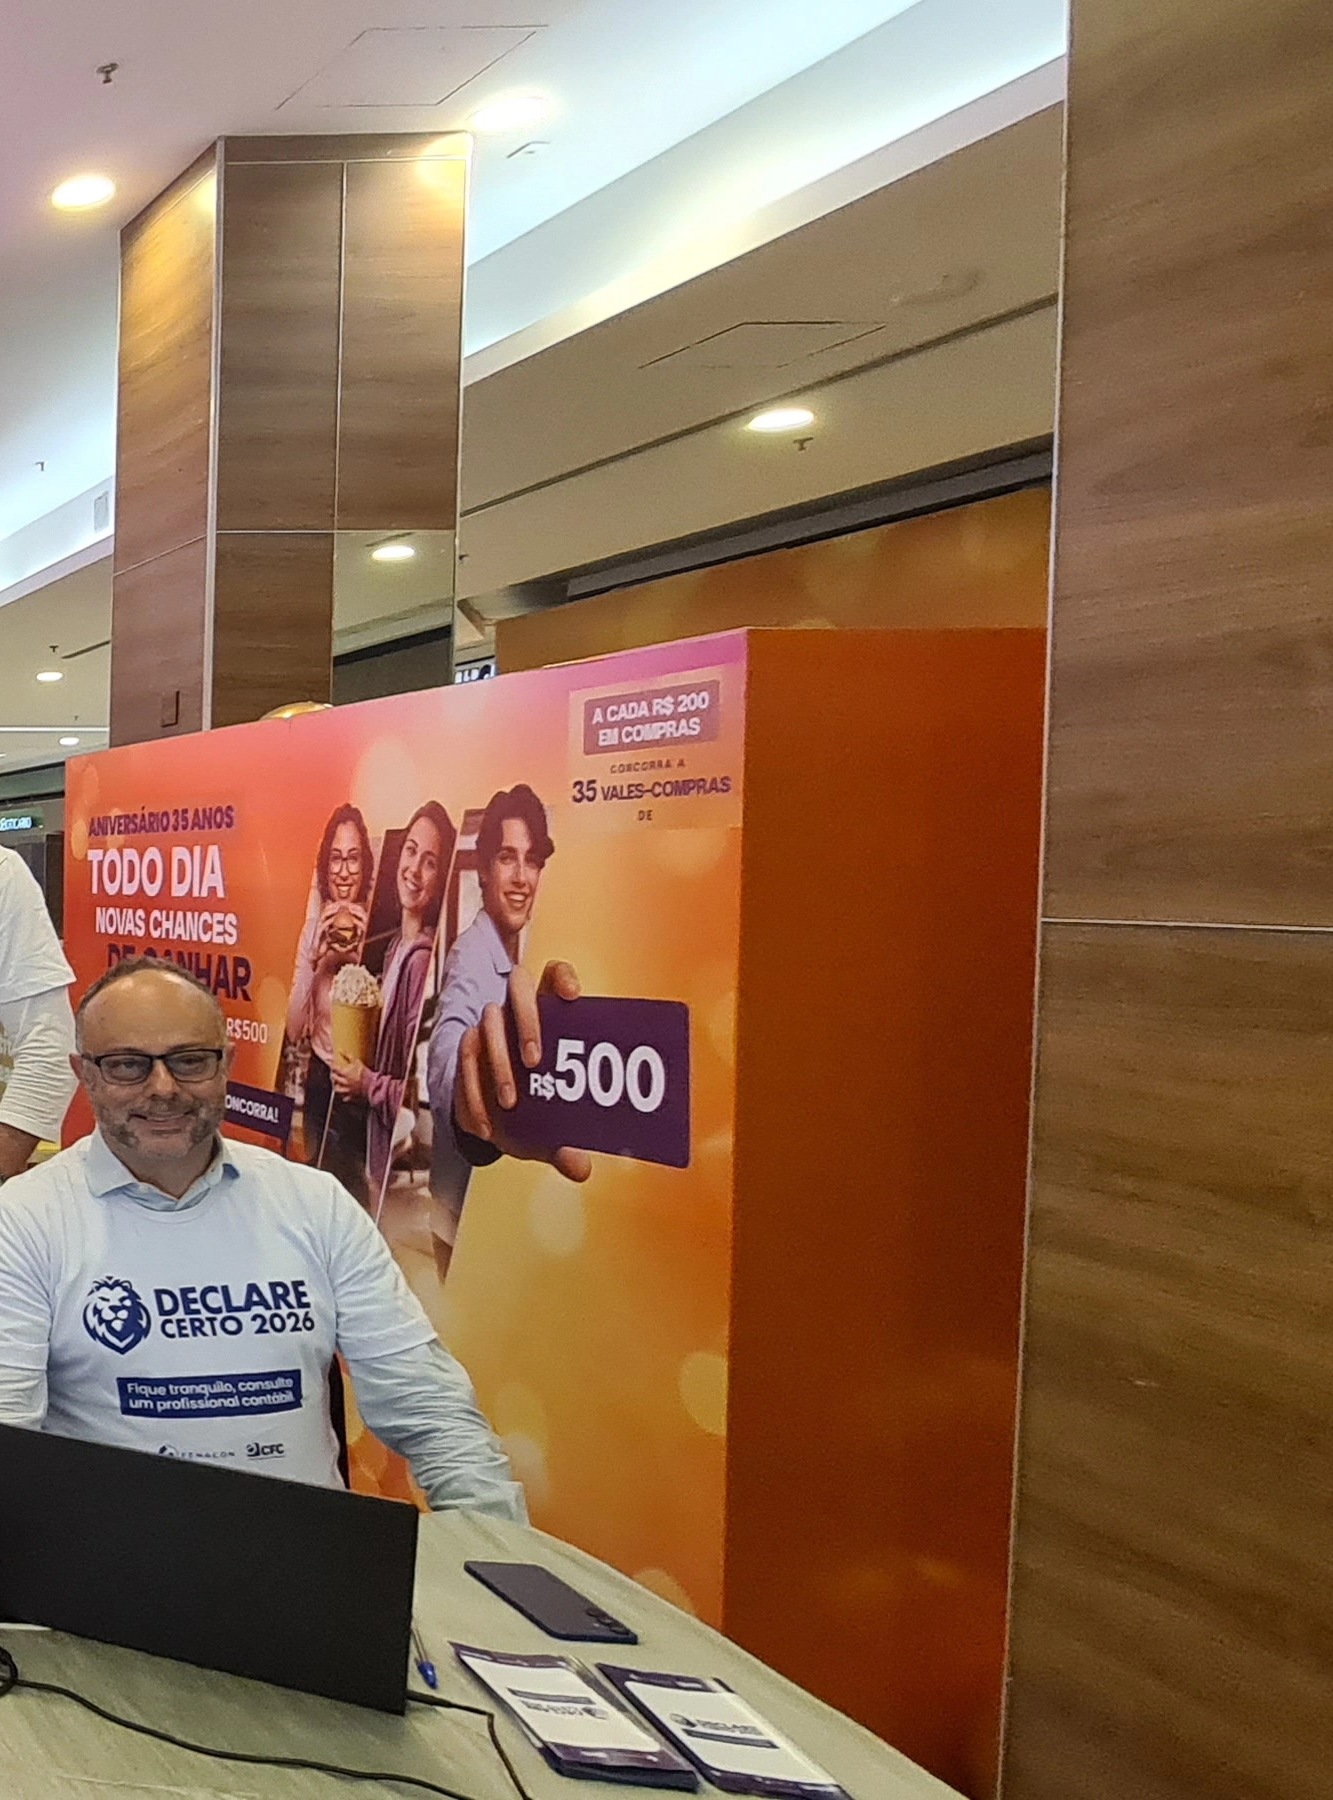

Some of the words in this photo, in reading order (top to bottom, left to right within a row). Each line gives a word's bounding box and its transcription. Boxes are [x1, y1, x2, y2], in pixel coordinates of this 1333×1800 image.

[591, 708, 604, 725] A
[606, 700, 649, 722] CADA
[652, 695, 674, 717] R$
[677, 691, 709, 712] 200
[598, 728, 619, 747] EM
[621, 717, 701, 743] COMPRAS
[572, 779, 598, 803] 35
[600, 776, 732, 801] VALES-COMPRAS
[88, 806, 170, 837] ANIVERSÁRIO
[171, 808, 189, 832] 35
[190, 805, 234, 831] ANOS
[637, 810, 653, 821] DE
[87, 846, 164, 897] TODO
[171, 844, 225, 898] DIA
[95, 907, 146, 937] NOVAS
[149, 909, 238, 945] CHANCES
[153, 1279, 312, 1317] DECLARE
[160, 1315, 243, 1339] CERTO
[250, 1310, 315, 1335] 2026
[127, 1383, 166, 1398] Fique
[168, 1380, 236, 1399] tranquilo,
[238, 1376, 294, 1392] consulte
[129, 1399, 154, 1409] um
[157, 1395, 239, 1413] profissional
[241, 1390, 295, 1407] contábil.
[261, 1443, 285, 1456] CFC
